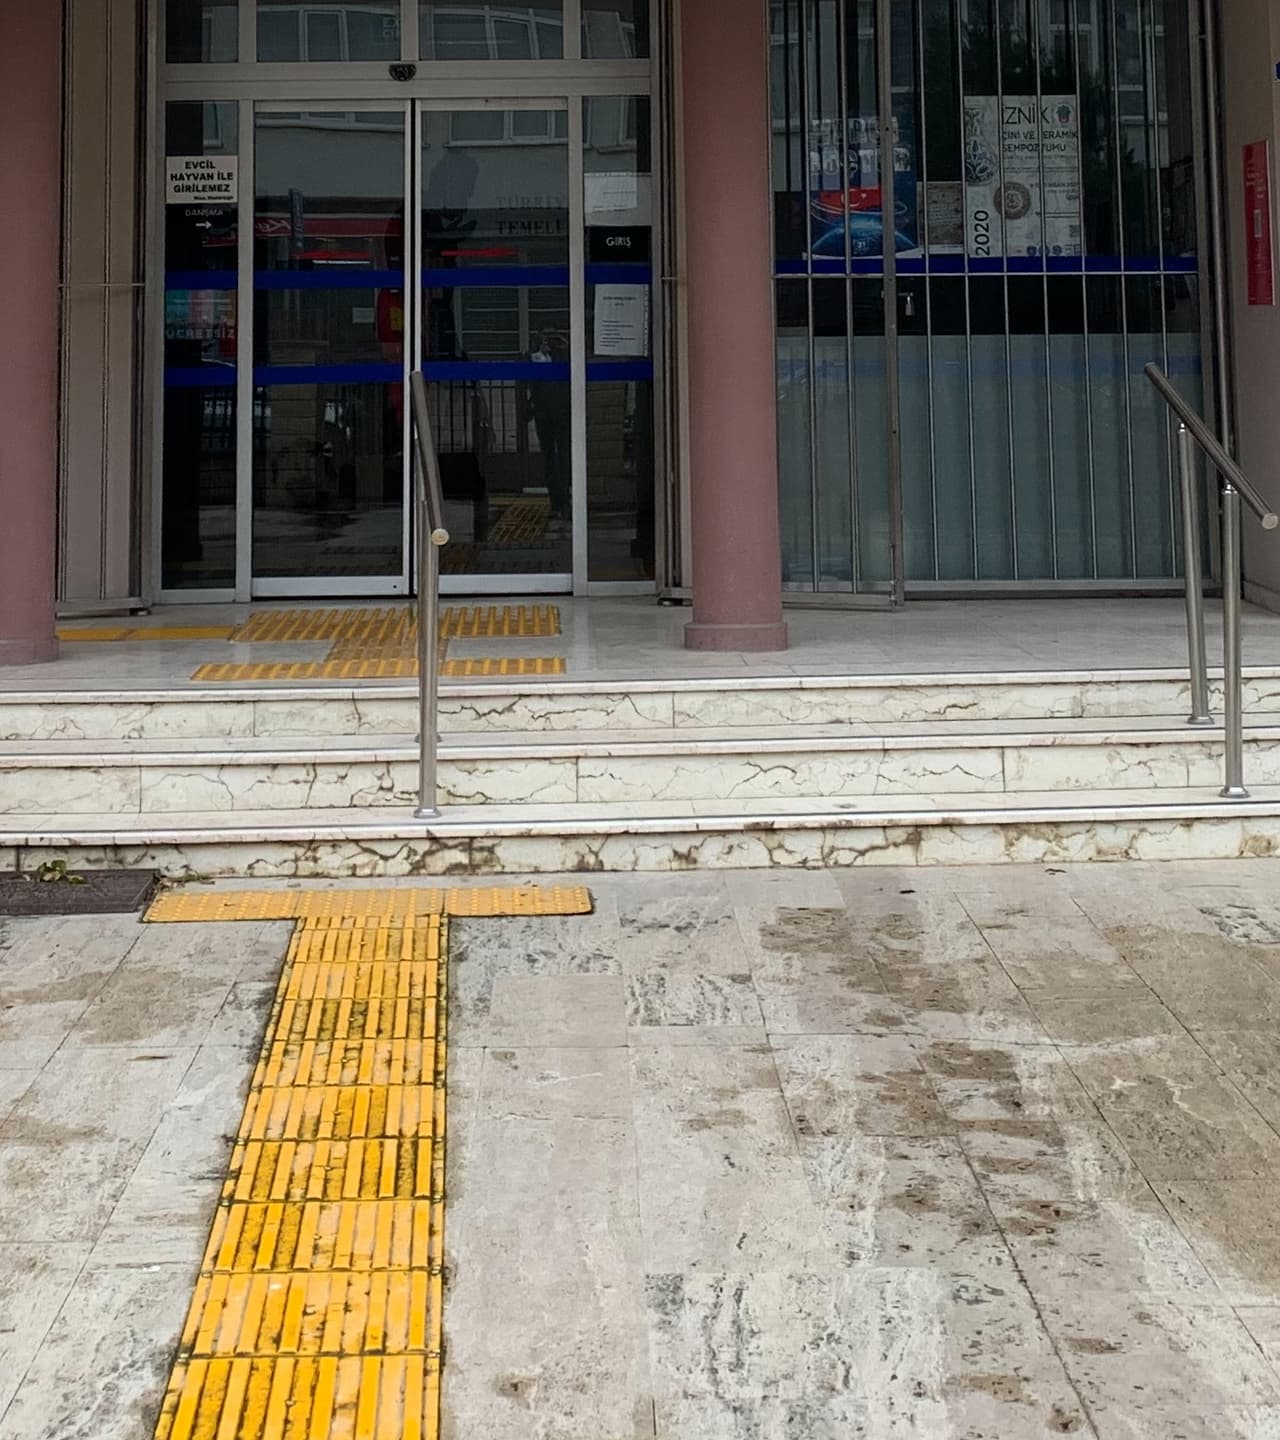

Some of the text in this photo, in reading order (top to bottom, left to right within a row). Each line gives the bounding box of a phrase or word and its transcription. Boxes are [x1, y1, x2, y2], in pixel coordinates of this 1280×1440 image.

[185, 160, 216, 169] EVCİL
[170, 172, 234, 181] HAYVAN İLE
[174, 183, 231, 193] GİRİLEMEZ
[974, 209, 990, 257] 2020
